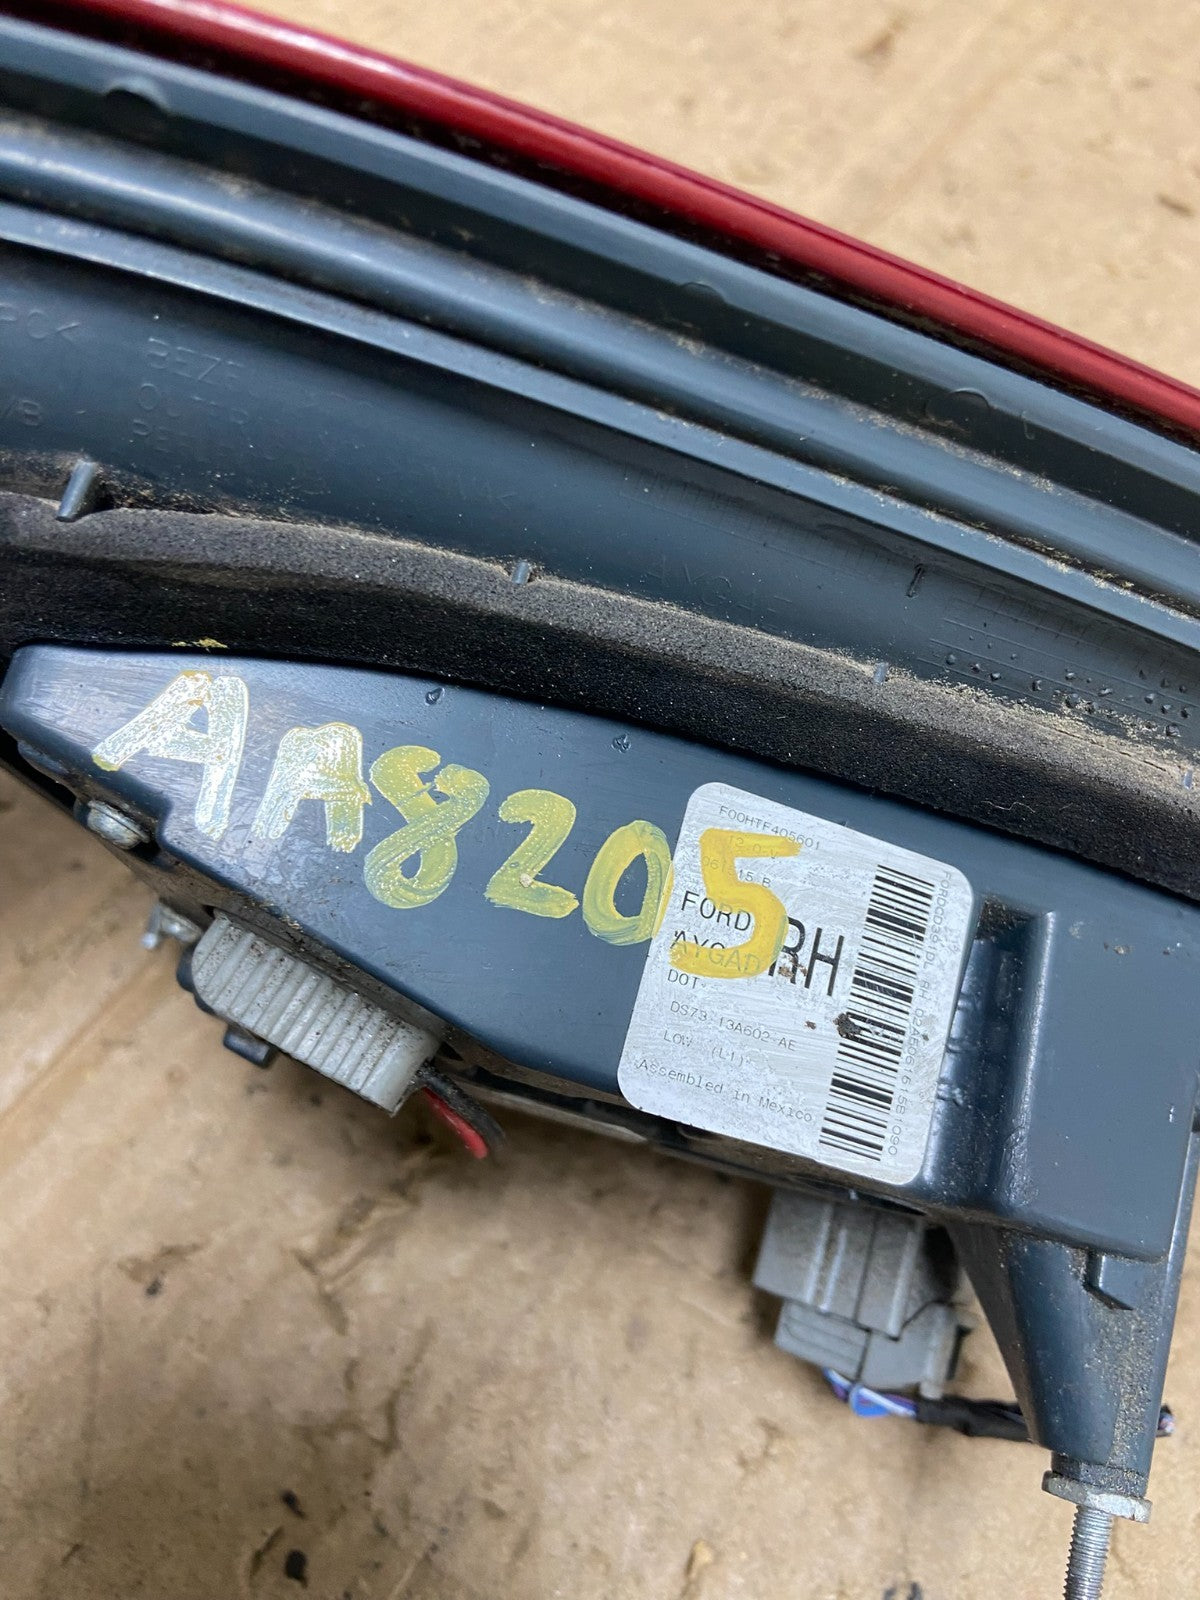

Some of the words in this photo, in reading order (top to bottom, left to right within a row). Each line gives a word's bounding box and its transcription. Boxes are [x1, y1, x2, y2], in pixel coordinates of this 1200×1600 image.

[681, 889, 751, 932] FORD
[667, 968, 700, 990] DOT
[768, 915, 845, 995] RH
[637, 1059, 724, 1095] Assembled
[734, 1089, 751, 1104] in
[758, 1096, 813, 1123] Mexico
